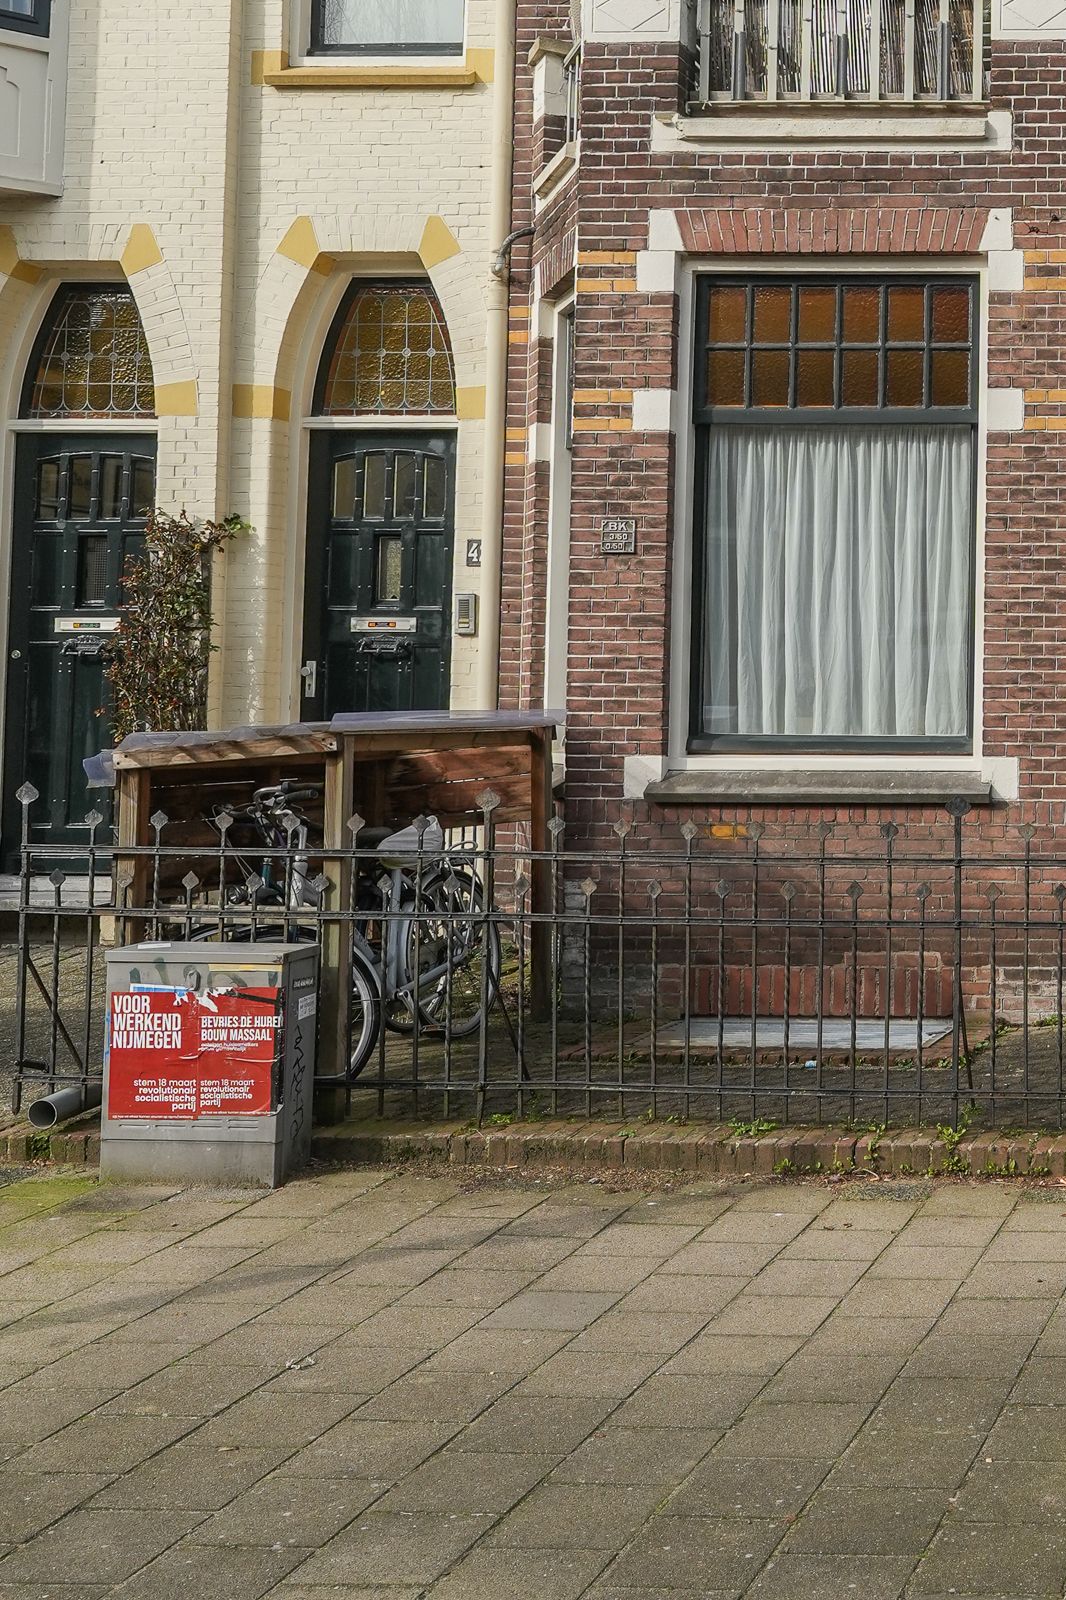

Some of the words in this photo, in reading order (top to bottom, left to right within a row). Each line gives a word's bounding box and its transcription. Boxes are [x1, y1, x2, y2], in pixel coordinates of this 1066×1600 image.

[609, 522, 627, 531] BK
[468, 543, 479, 562] 4
[113, 995, 151, 1014] VOOR
[113, 1013, 182, 1031] WERKEND
[201, 1015, 239, 1028] BEVRIES
[240, 1015, 253, 1028] DE
[112, 1030, 182, 1049] NIJMEGEN
[201, 1028, 228, 1041] BOUW
[229, 1028, 273, 1041] MASSAAL
[133, 1079, 157, 1087] stem
[158, 1078, 167, 1087] 18
[168, 1079, 197, 1087] maart
[138, 1086, 197, 1094] revolutionair
[200, 1085, 250, 1093] revolutionair
[135, 1094, 197, 1102] socialistische
[200, 1099, 221, 1108] partij
[171, 1101, 196, 1112] partij
